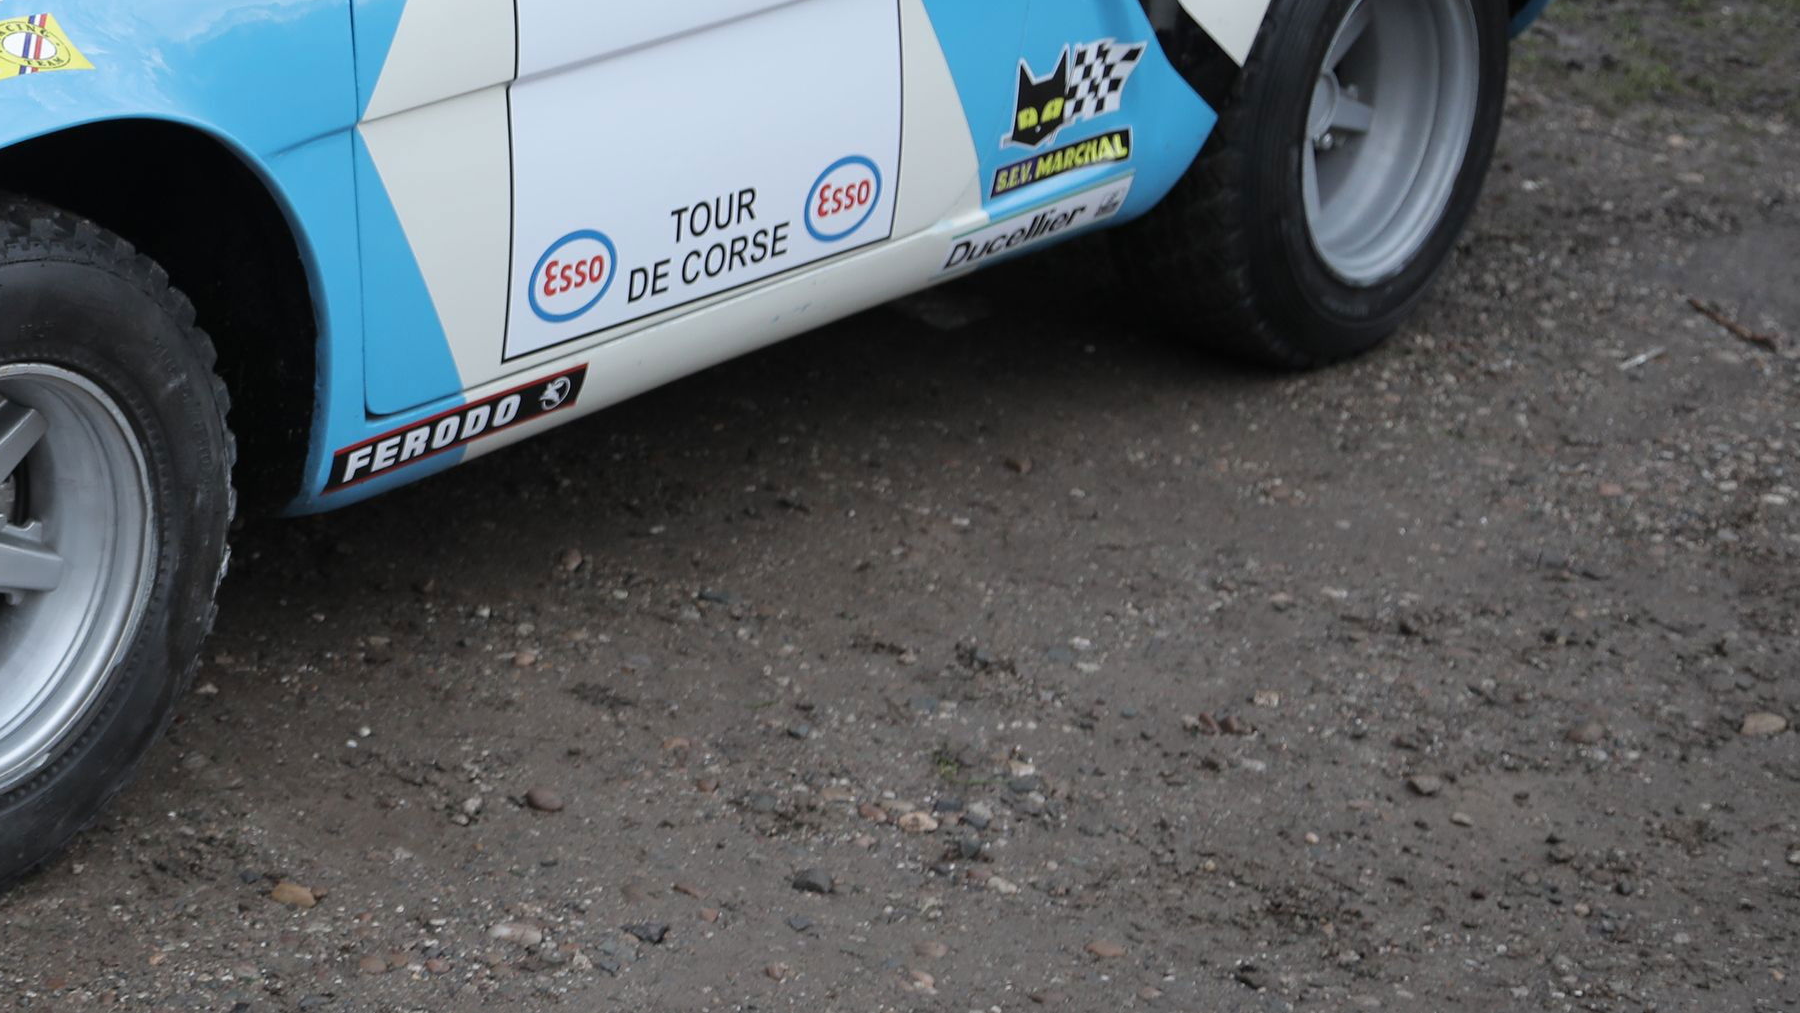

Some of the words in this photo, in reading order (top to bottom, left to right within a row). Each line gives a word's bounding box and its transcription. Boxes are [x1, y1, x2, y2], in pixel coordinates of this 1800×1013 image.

[25, 56, 65, 67] TEAM
[1034, 133, 1128, 180] MARCHAL
[670, 187, 758, 244] TOUR
[943, 204, 1087, 271] Ducellier
[627, 258, 672, 304] DE
[681, 221, 791, 286] CORSE
[342, 393, 522, 484] FERODO
